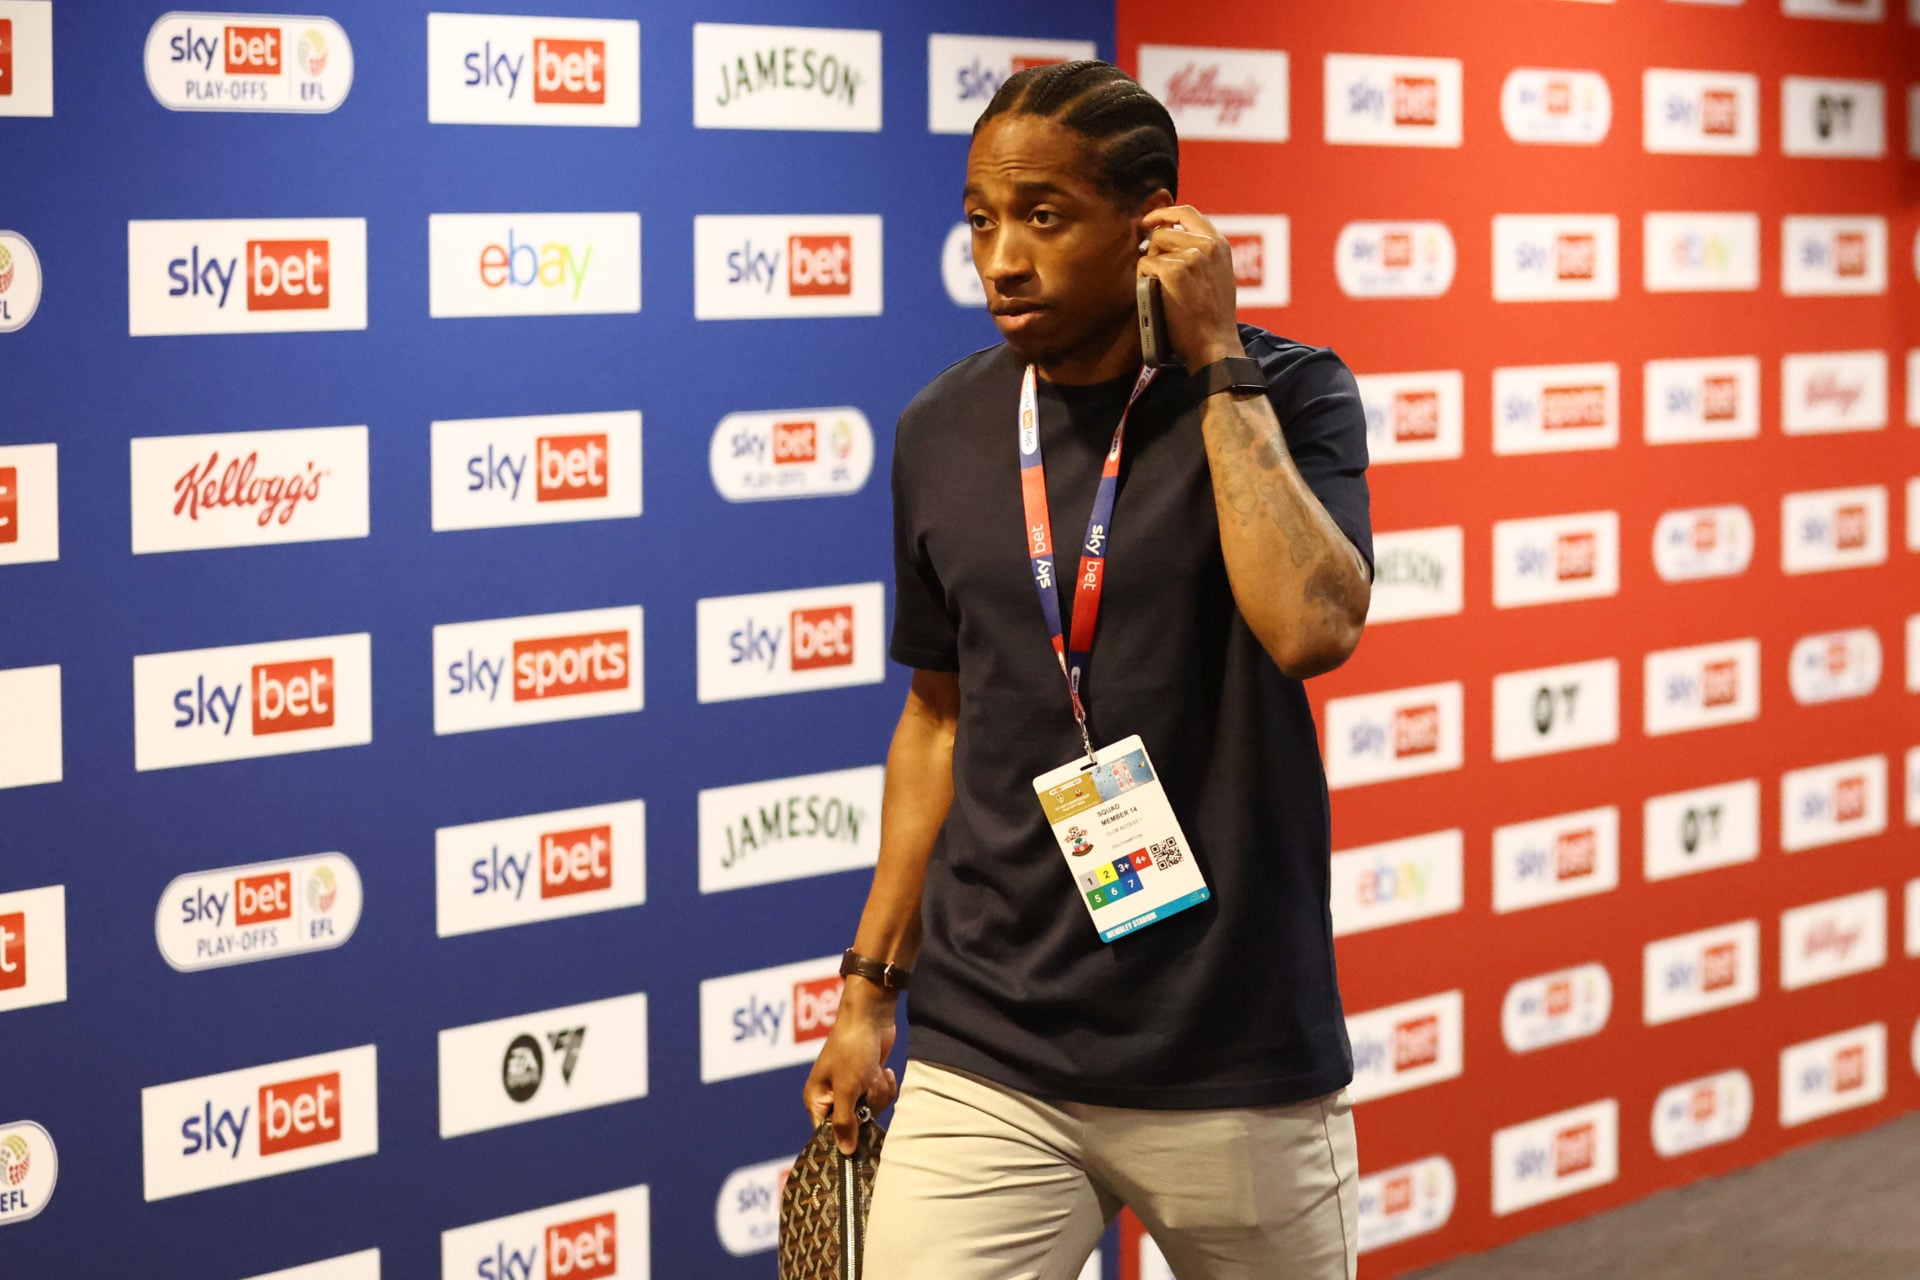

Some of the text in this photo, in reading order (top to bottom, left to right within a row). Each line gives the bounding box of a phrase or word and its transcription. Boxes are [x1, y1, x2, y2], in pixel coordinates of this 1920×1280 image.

[170, 28, 278, 71] sky bet
[464, 42, 602, 99] sky bet
[717, 47, 857, 107] JAMESON
[185, 80, 268, 101] PLAY-OFFS
[300, 82, 325, 101] EFL
[168, 246, 323, 308] sky bet
[479, 228, 593, 300] ebay
[727, 240, 849, 292] sky bet
[173, 450, 322, 527] Kellogg's
[467, 441, 604, 500] sky bet
[1032, 523, 1051, 589] sky bet
[1083, 524, 1104, 591] sky bet
[448, 638, 626, 701] sky sports
[730, 611, 850, 671] sky bet
[173, 668, 328, 736] sky bet
[720, 794, 860, 869] JAMESON
[1097, 803, 1120, 817] SQUAD
[1101, 806, 1138, 826] MEMBER 14
[471, 832, 608, 900] sky bet
[1094, 879, 1136, 903] 5 6 7
[1103, 870, 1111, 879] 2
[1118, 862, 1130, 873] 3+
[1134, 855, 1147, 866] 4+
[182, 877, 287, 927] sky bet
[309, 918, 335, 939] EFL
[197, 928, 279, 958] PLAY-OFFS
[732, 981, 843, 1045] sky be
[182, 1083, 334, 1158] sky bet
[0, 1189, 28, 1212] EFL
[551, 1222, 612, 1276] bet
